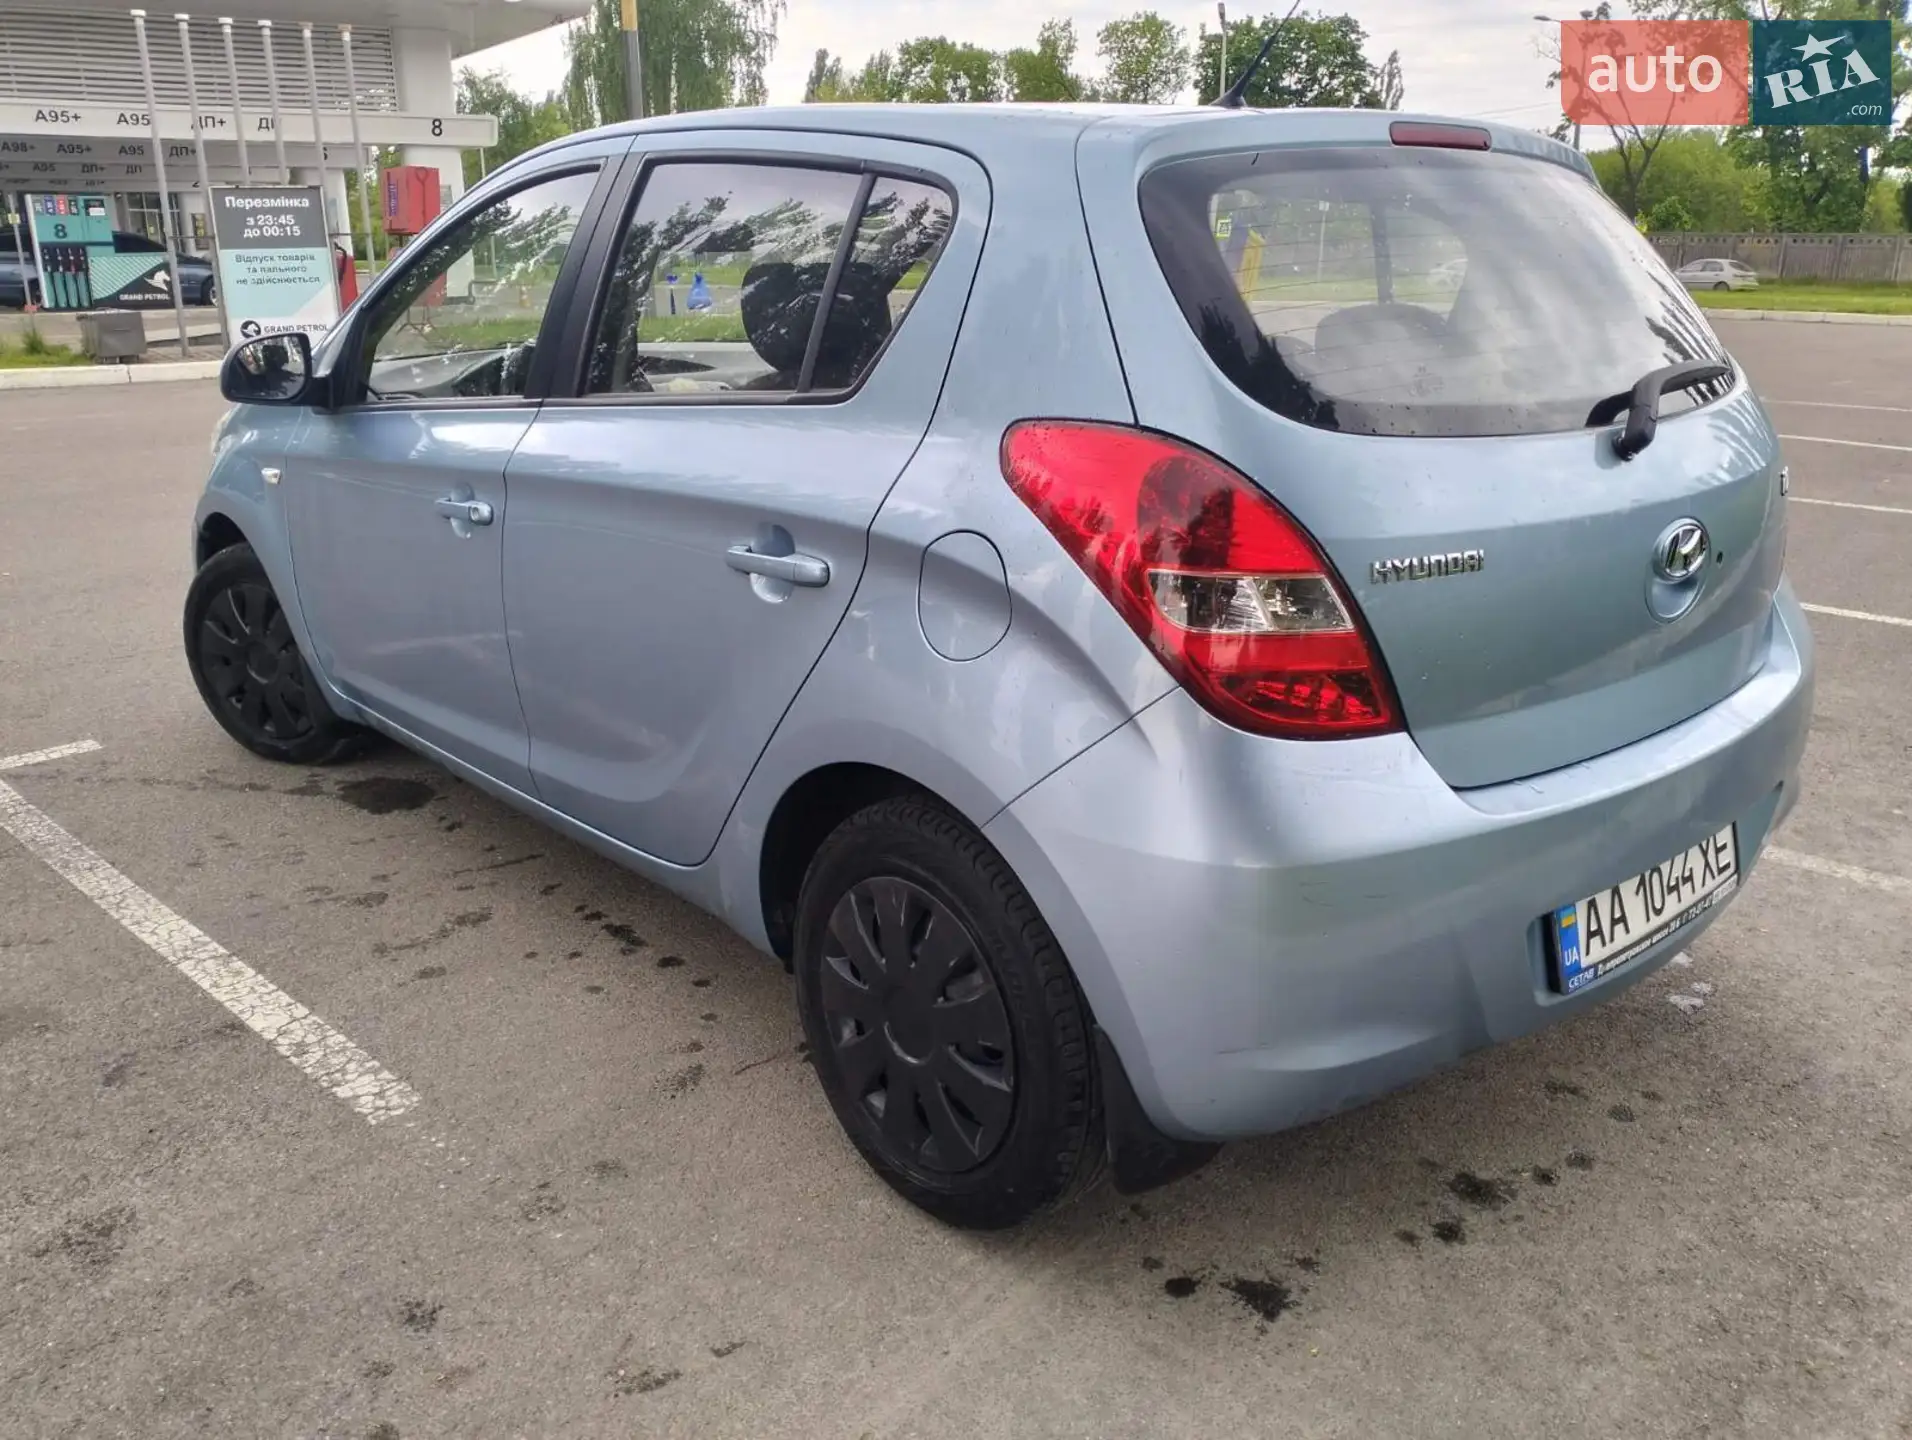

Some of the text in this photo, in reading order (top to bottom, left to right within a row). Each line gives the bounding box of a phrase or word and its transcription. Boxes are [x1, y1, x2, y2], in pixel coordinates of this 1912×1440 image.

[431, 118, 443, 137] 8
[225, 196, 310, 209] Перезмінка
[257, 214, 295, 225] 23:45
[54, 223, 67, 239] 8
[243, 226, 301, 238] до 00:15
[235, 254, 275, 264] Відпуск
[263, 324, 328, 334] GRAND PETROL
[1369, 549, 1484, 584] HYUNDAI
[1585, 885, 1630, 956] AA
[1635, 851, 1696, 924] 1044
[1698, 834, 1731, 888] XE
[1564, 947, 1580, 967] UA
